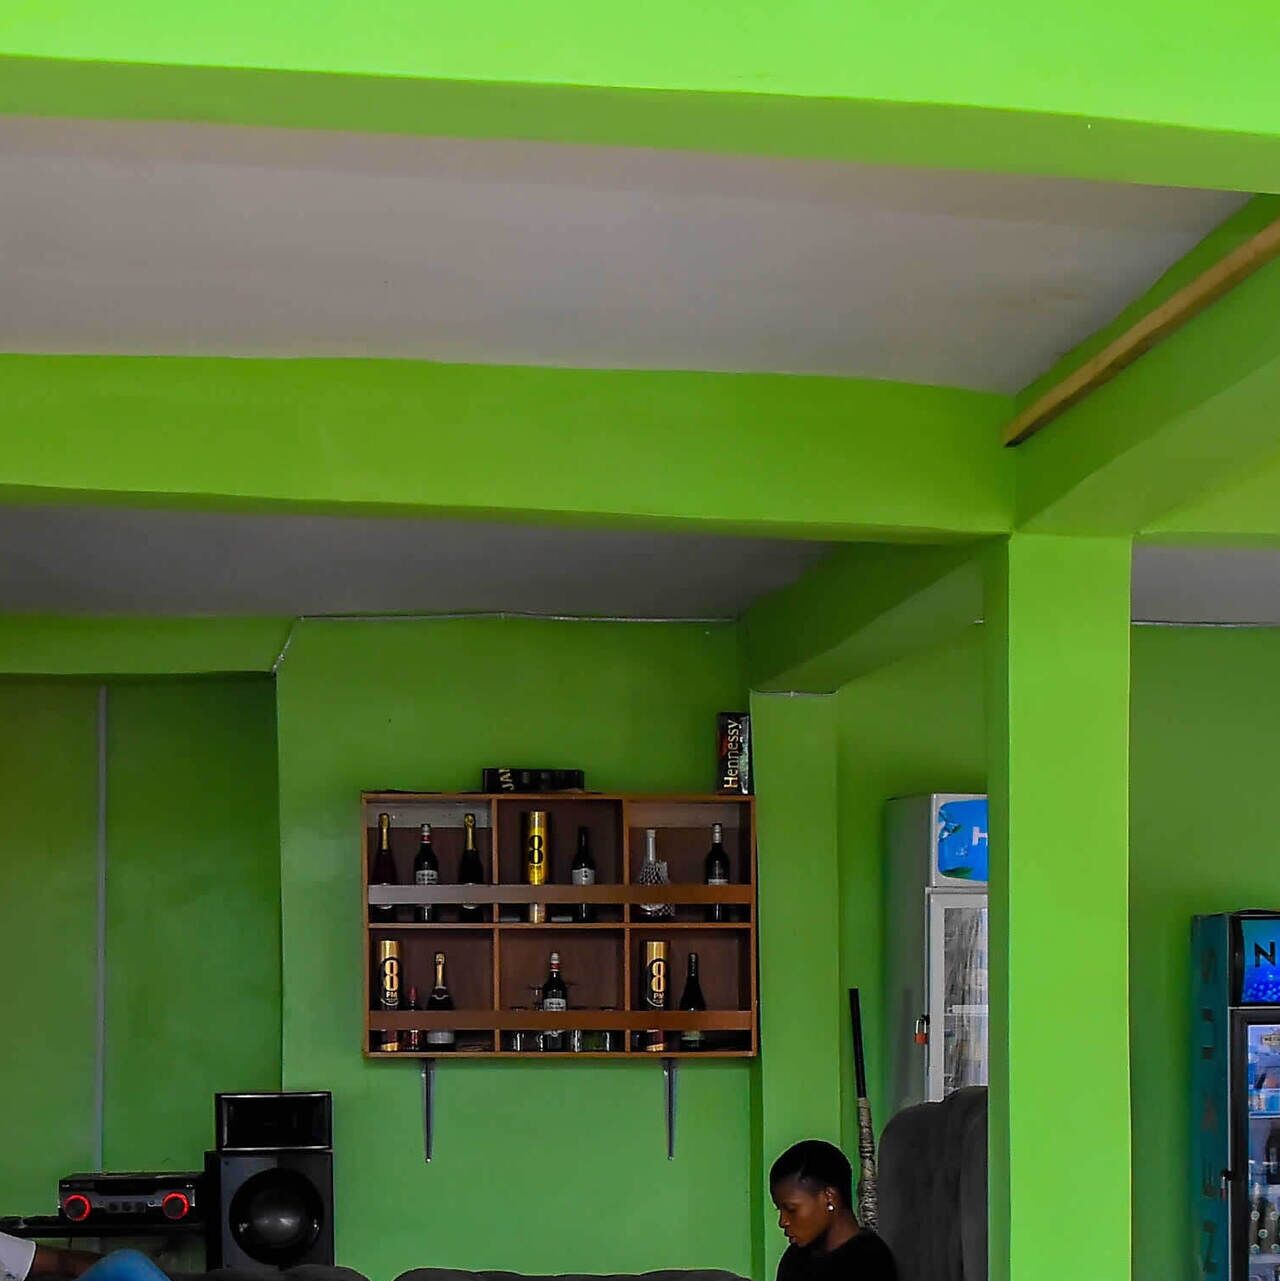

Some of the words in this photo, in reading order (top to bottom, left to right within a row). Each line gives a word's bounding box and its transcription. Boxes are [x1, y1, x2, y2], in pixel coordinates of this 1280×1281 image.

[723, 719, 741, 788] Hennessy
[384, 960, 399, 991] 8
[651, 961, 665, 992] 8
